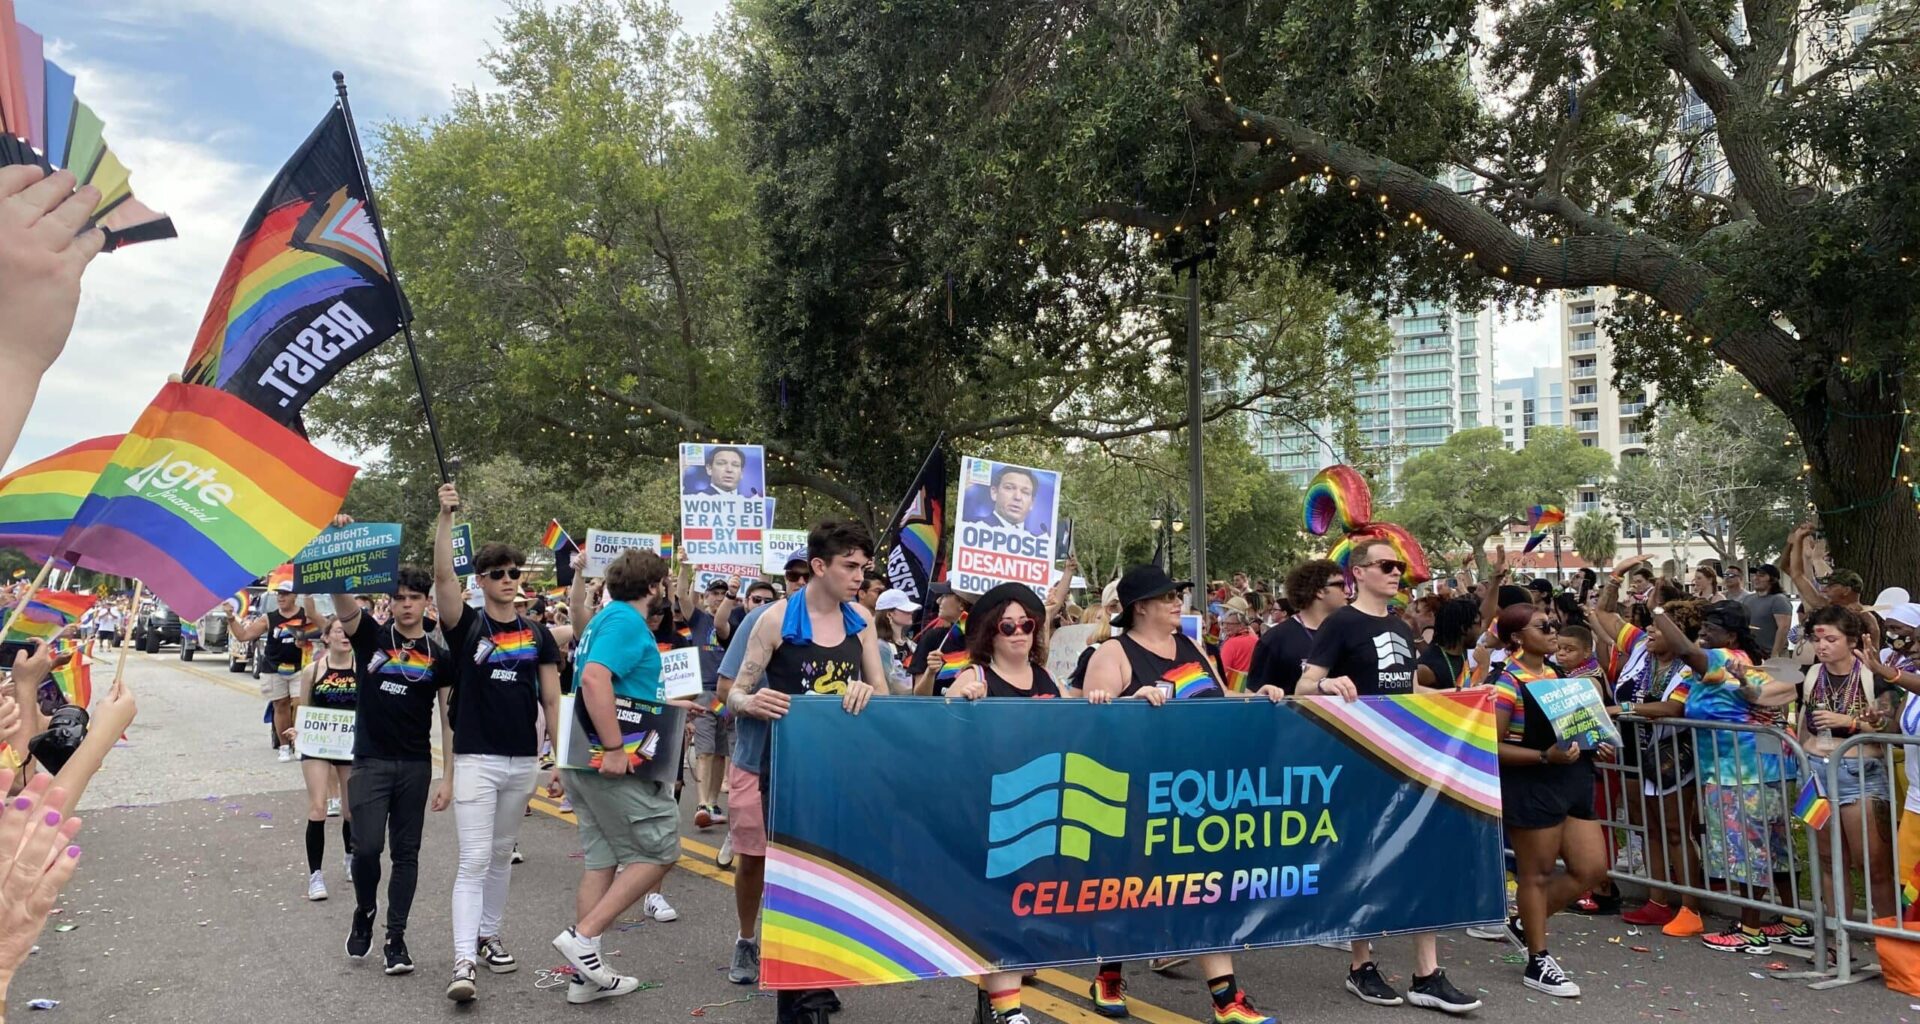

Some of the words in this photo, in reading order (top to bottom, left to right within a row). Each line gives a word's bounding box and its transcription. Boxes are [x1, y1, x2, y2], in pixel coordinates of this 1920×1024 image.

[151, 461, 234, 507] gte
[146, 488, 219, 522] financial
[684, 500, 736, 514] WON'T
[744, 501, 763, 514] BE
[685, 514, 763, 527] ERASED
[306, 533, 331, 547] EPRO
[333, 526, 369, 541] RIGHTS
[595, 535, 619, 544] FREE
[621, 537, 654, 546] STATES
[715, 529, 734, 540] BY
[769, 533, 794, 541] FREE
[963, 526, 1049, 559] OPPOSE
[300, 546, 320, 560] ARE
[322, 541, 353, 555] LGBTQ
[355, 534, 395, 548] RIGHTS.
[687, 541, 762, 555] DESANTIS
[301, 560, 331, 574] LGBTQ
[333, 553, 367, 568] RIGHTS
[368, 549, 388, 560] ARE
[303, 570, 333, 584] REPRO
[335, 563, 371, 578] RIGHTS.
[664, 661, 689, 673] BAN
[1378, 671, 1411, 682] EQUALITY
[305, 712, 330, 721] FREE
[304, 720, 338, 732] DON'T
[1147, 765, 1343, 818] EQUALITY
[1145, 808, 1339, 856] FLORIDA
[1011, 871, 1223, 917] CELEBRATES
[1230, 863, 1320, 902] PRIDE
